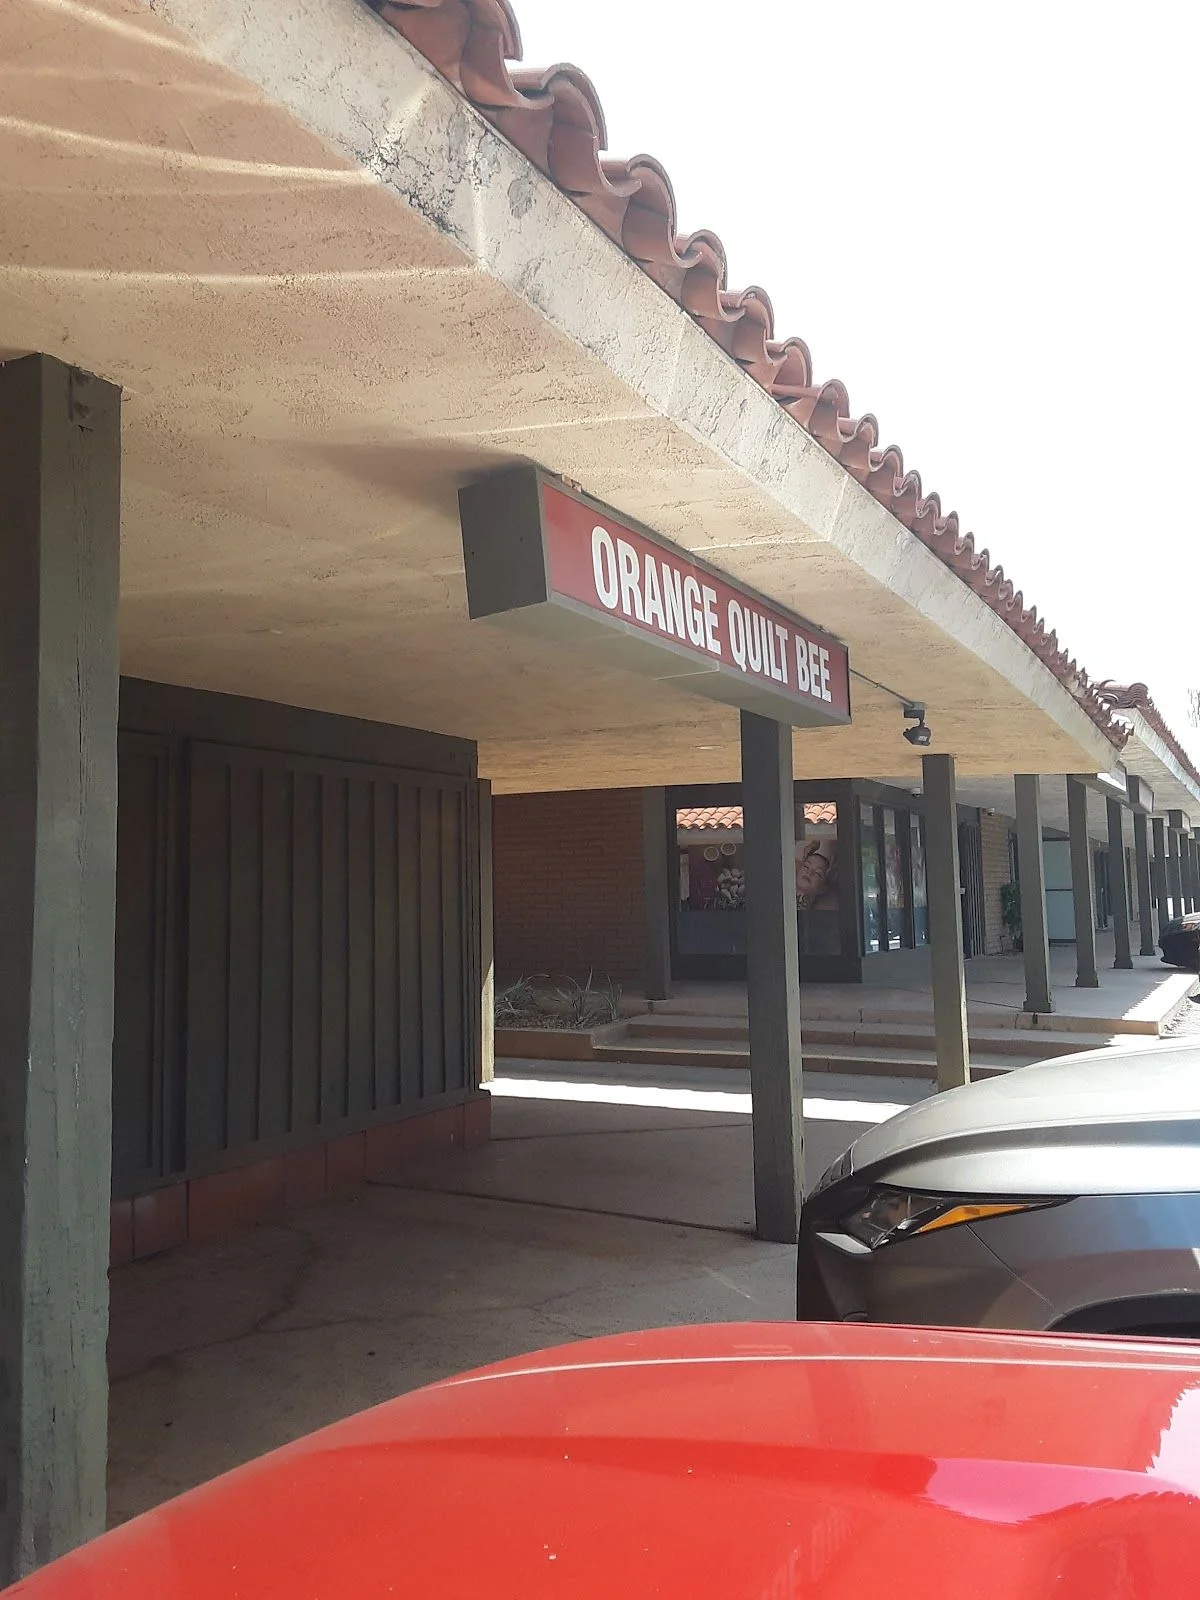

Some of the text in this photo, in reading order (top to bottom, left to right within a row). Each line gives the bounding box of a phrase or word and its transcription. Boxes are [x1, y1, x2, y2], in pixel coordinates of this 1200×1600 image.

[591, 525, 832, 703] ORANGE QUILT BEE
